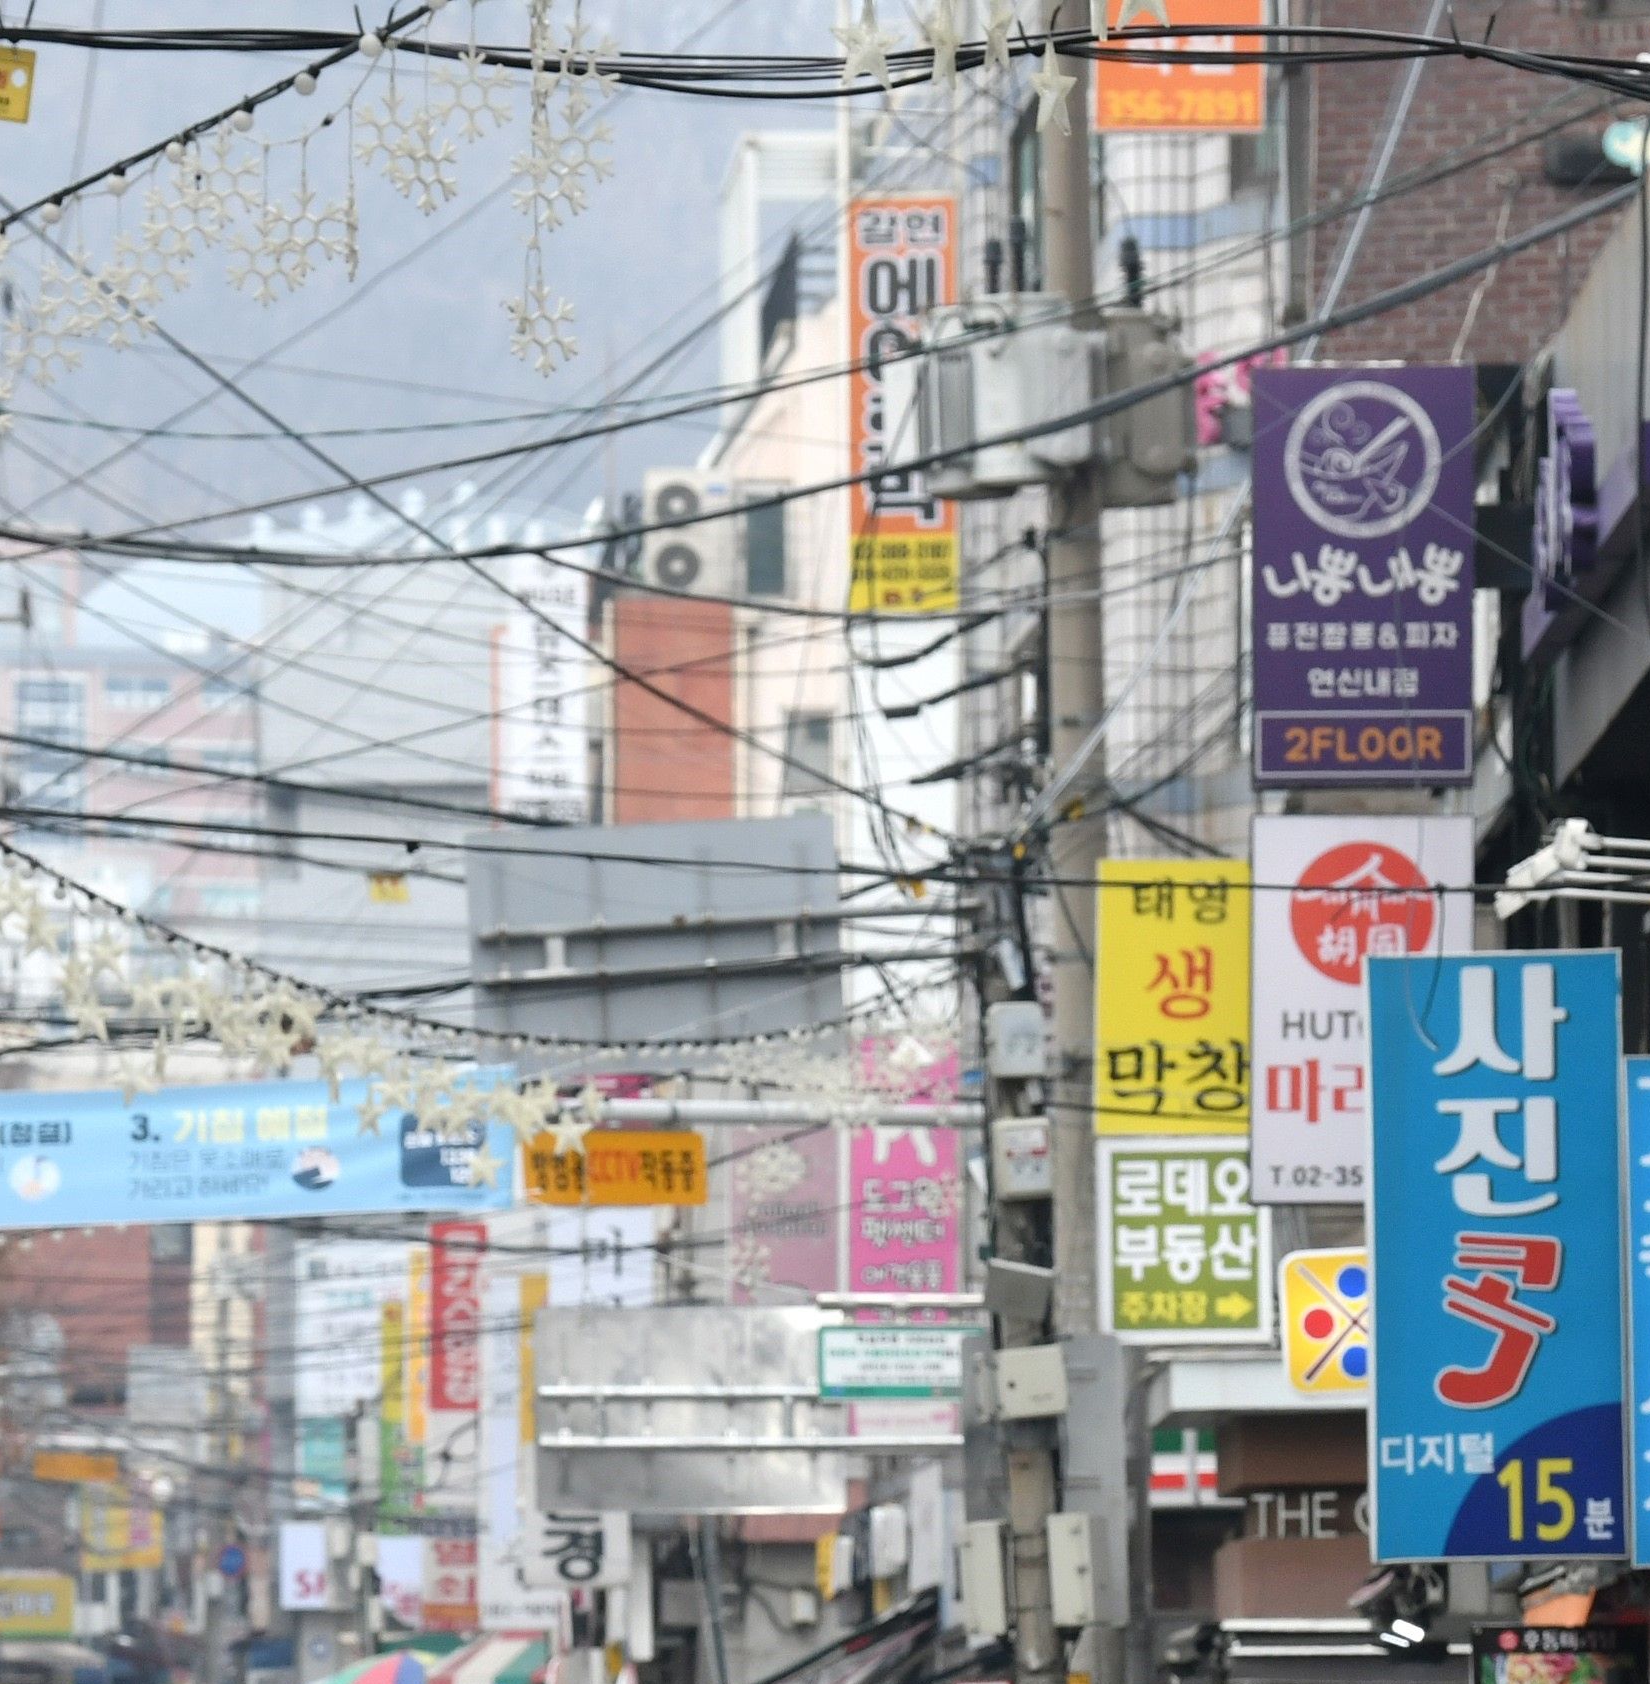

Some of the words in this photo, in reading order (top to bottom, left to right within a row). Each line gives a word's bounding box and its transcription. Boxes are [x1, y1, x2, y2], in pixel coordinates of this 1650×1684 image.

[1306, 666, 1418, 698] 연신내점
[1285, 726, 1442, 762] 2FLOOR
[1133, 876, 1229, 920] 태영
[1145, 943, 1215, 1020] 생
[1282, 1011, 1363, 1040] HUT
[1105, 1037, 1251, 1112] 막창
[1115, 1157, 1252, 1216] 로데오
[1112, 1225, 1256, 1283] 부동산
[1380, 1433, 1496, 1476] 디지털
[1250, 1492, 1340, 1539] THE
[1495, 1458, 1577, 1543] 15
[1585, 1496, 1616, 1541] 분
